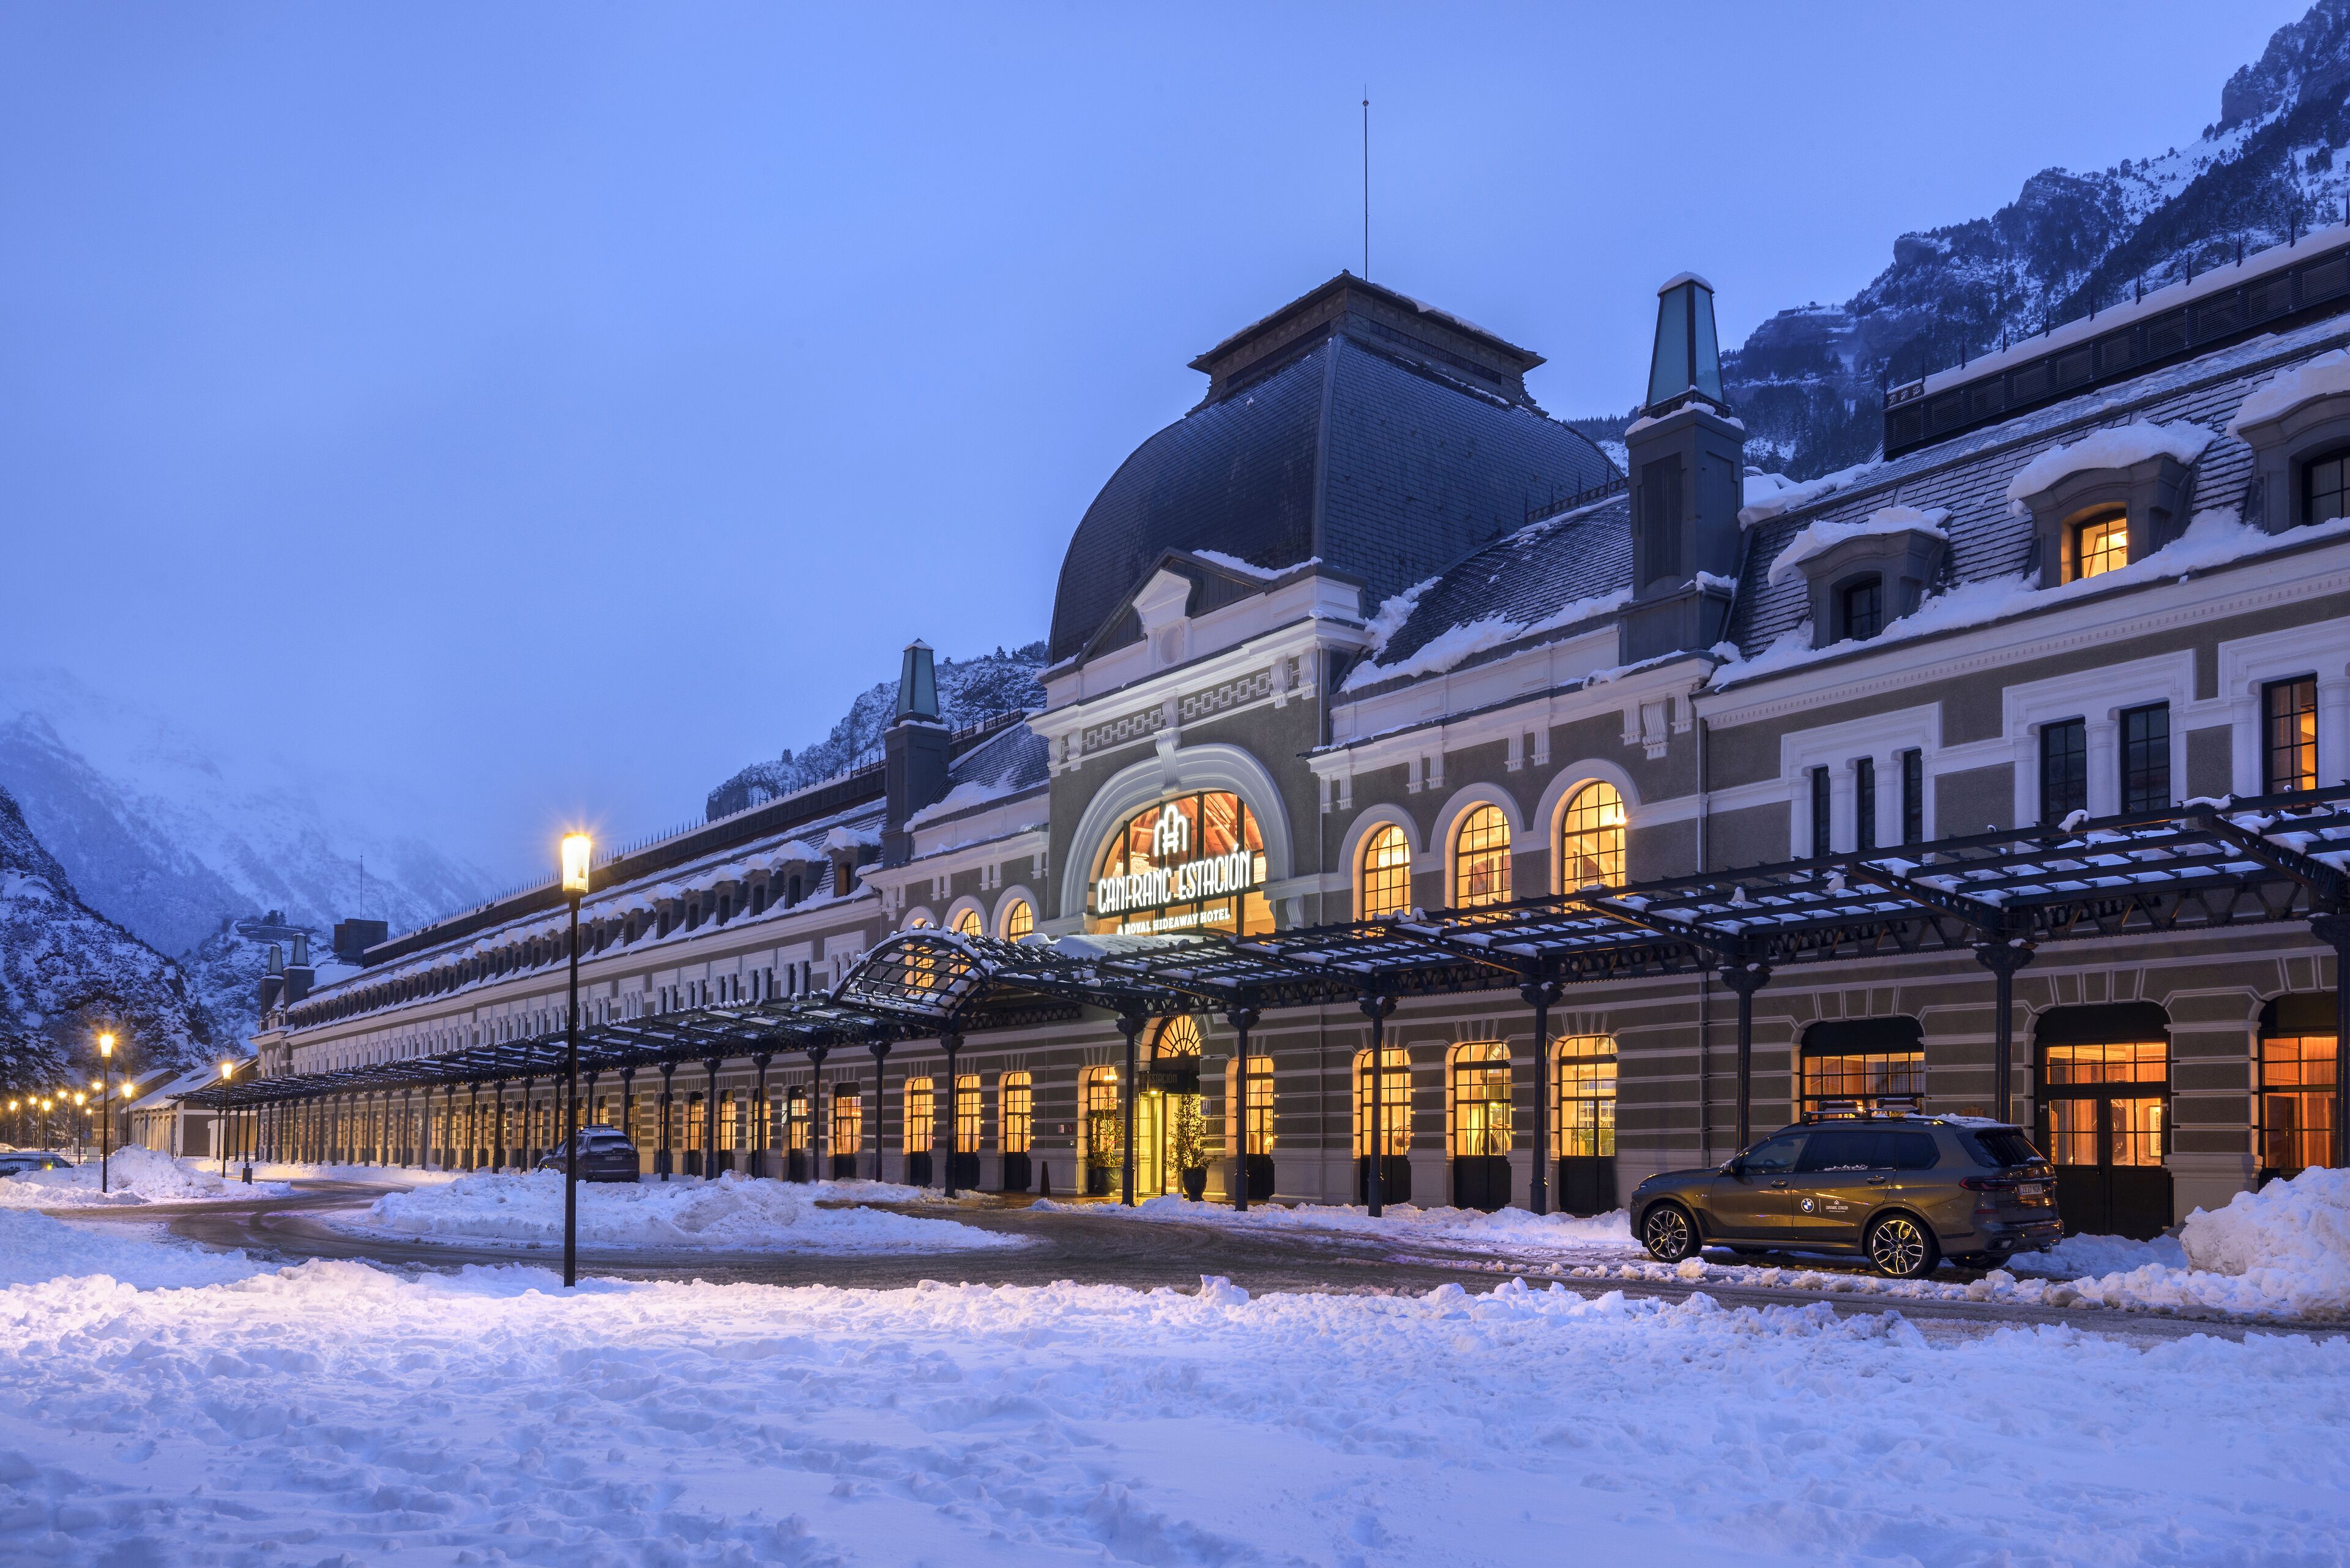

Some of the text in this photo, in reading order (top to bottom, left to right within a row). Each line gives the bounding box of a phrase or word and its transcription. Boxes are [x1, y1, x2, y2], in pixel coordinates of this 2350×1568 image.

[1097, 843, 1250, 914] CANFRANC ESTACIÓN
[1117, 908, 1231, 935] A ROYAL HIDEAWAY HOTEL
